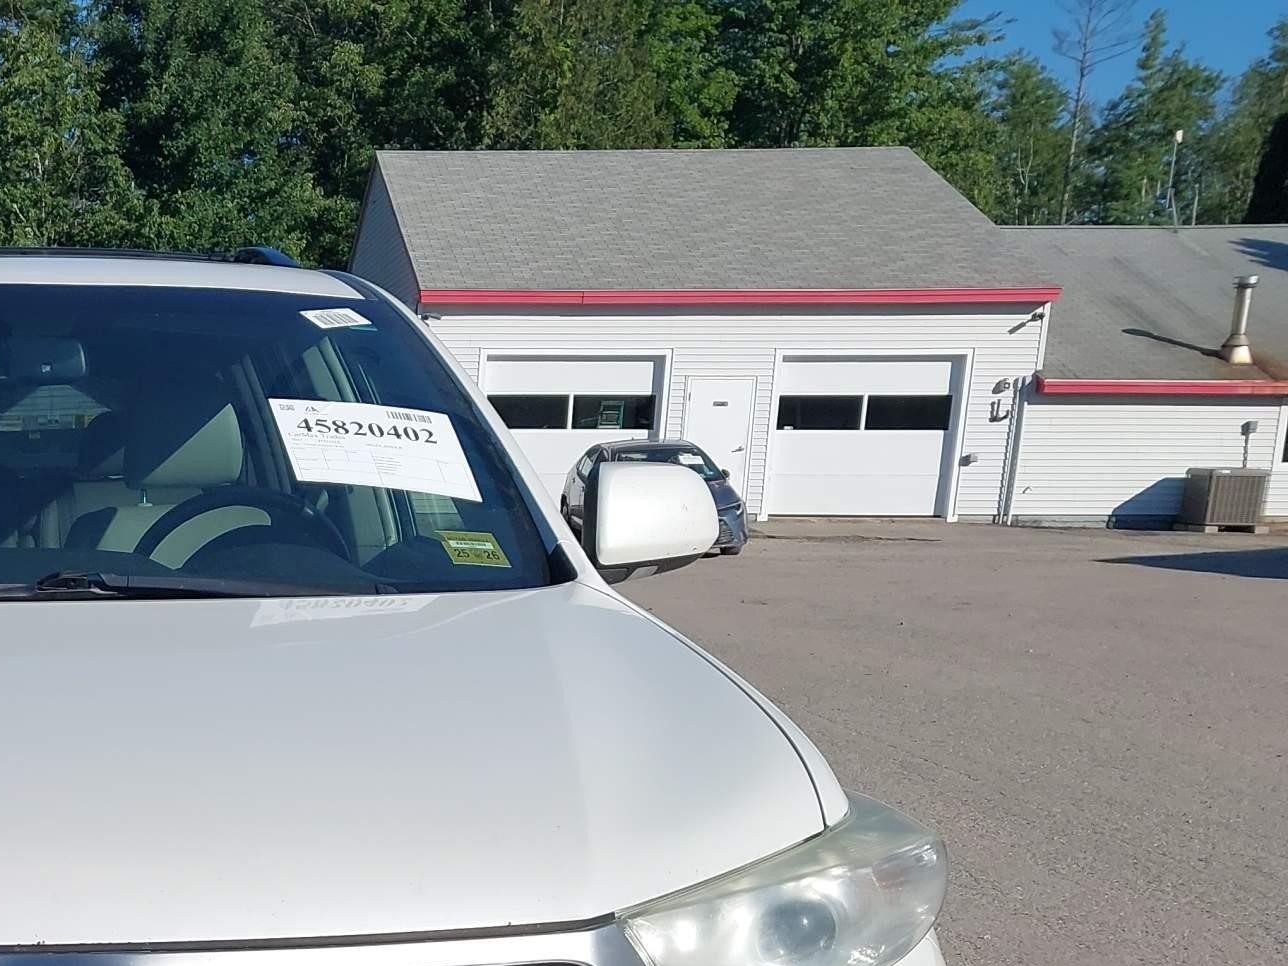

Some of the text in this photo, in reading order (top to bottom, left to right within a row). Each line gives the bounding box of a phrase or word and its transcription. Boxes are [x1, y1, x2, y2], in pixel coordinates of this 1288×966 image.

[296, 417, 438, 444] 45820402
[454, 548, 500, 560] 25 26
